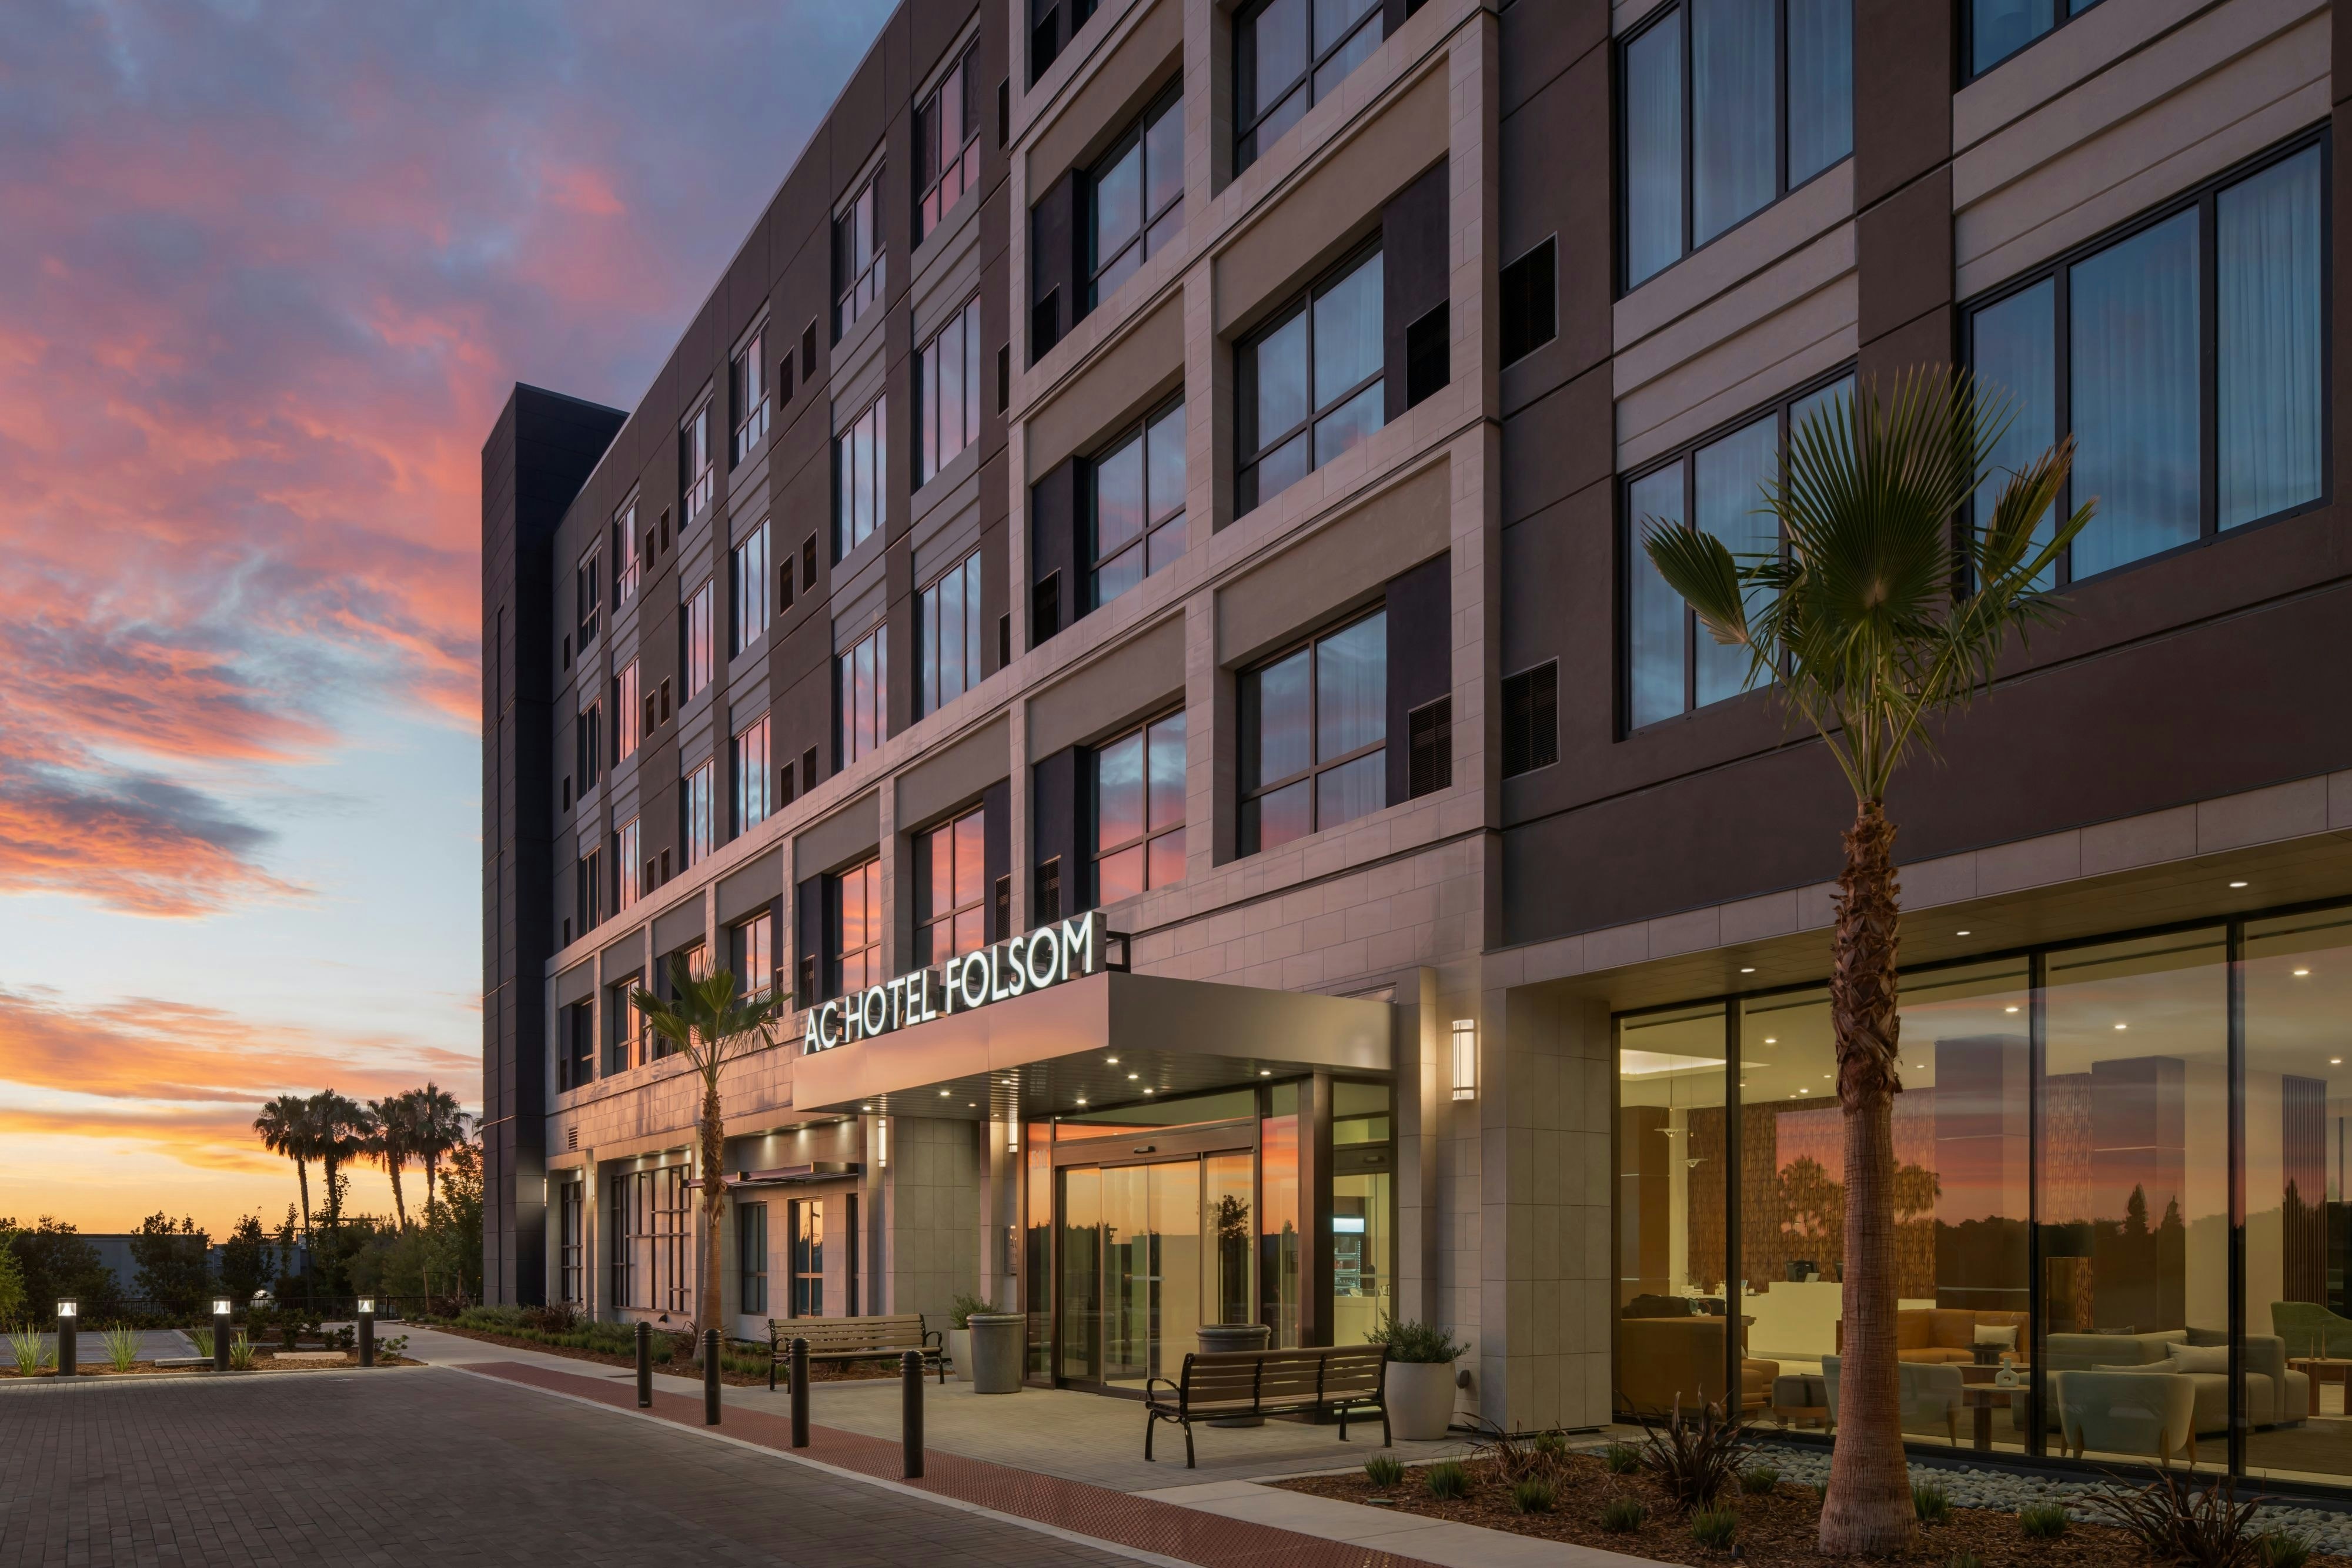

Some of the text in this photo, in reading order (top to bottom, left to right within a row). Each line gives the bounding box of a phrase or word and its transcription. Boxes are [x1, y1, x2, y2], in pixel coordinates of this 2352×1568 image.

[803, 911, 1093, 1055] AC HOTEL FOLSOM
